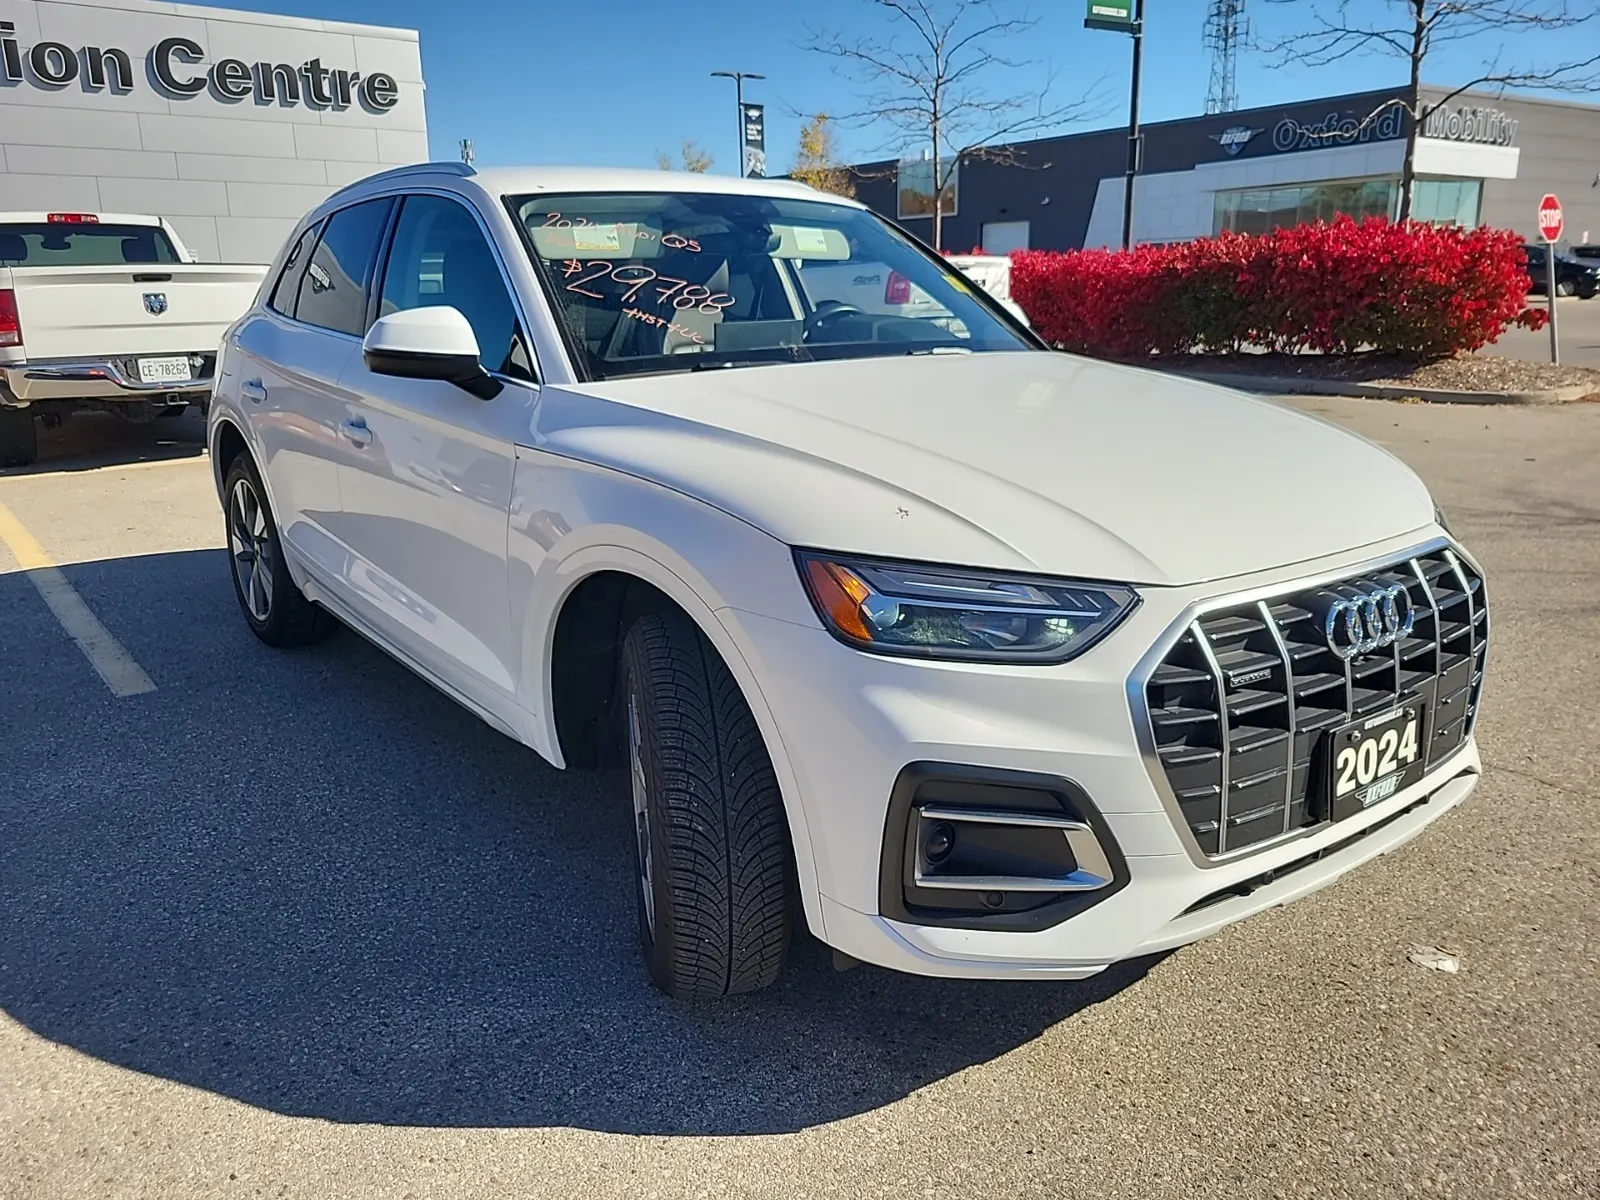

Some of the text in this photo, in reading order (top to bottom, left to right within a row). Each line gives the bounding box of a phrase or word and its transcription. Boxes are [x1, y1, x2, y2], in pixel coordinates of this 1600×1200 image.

[152, 36, 400, 111] Centre
[1272, 103, 1519, 151] Oxford Mobility
[1540, 208, 1563, 228] STOP
[660, 234, 702, 252] Q5
[1336, 719, 1418, 798] 2024
